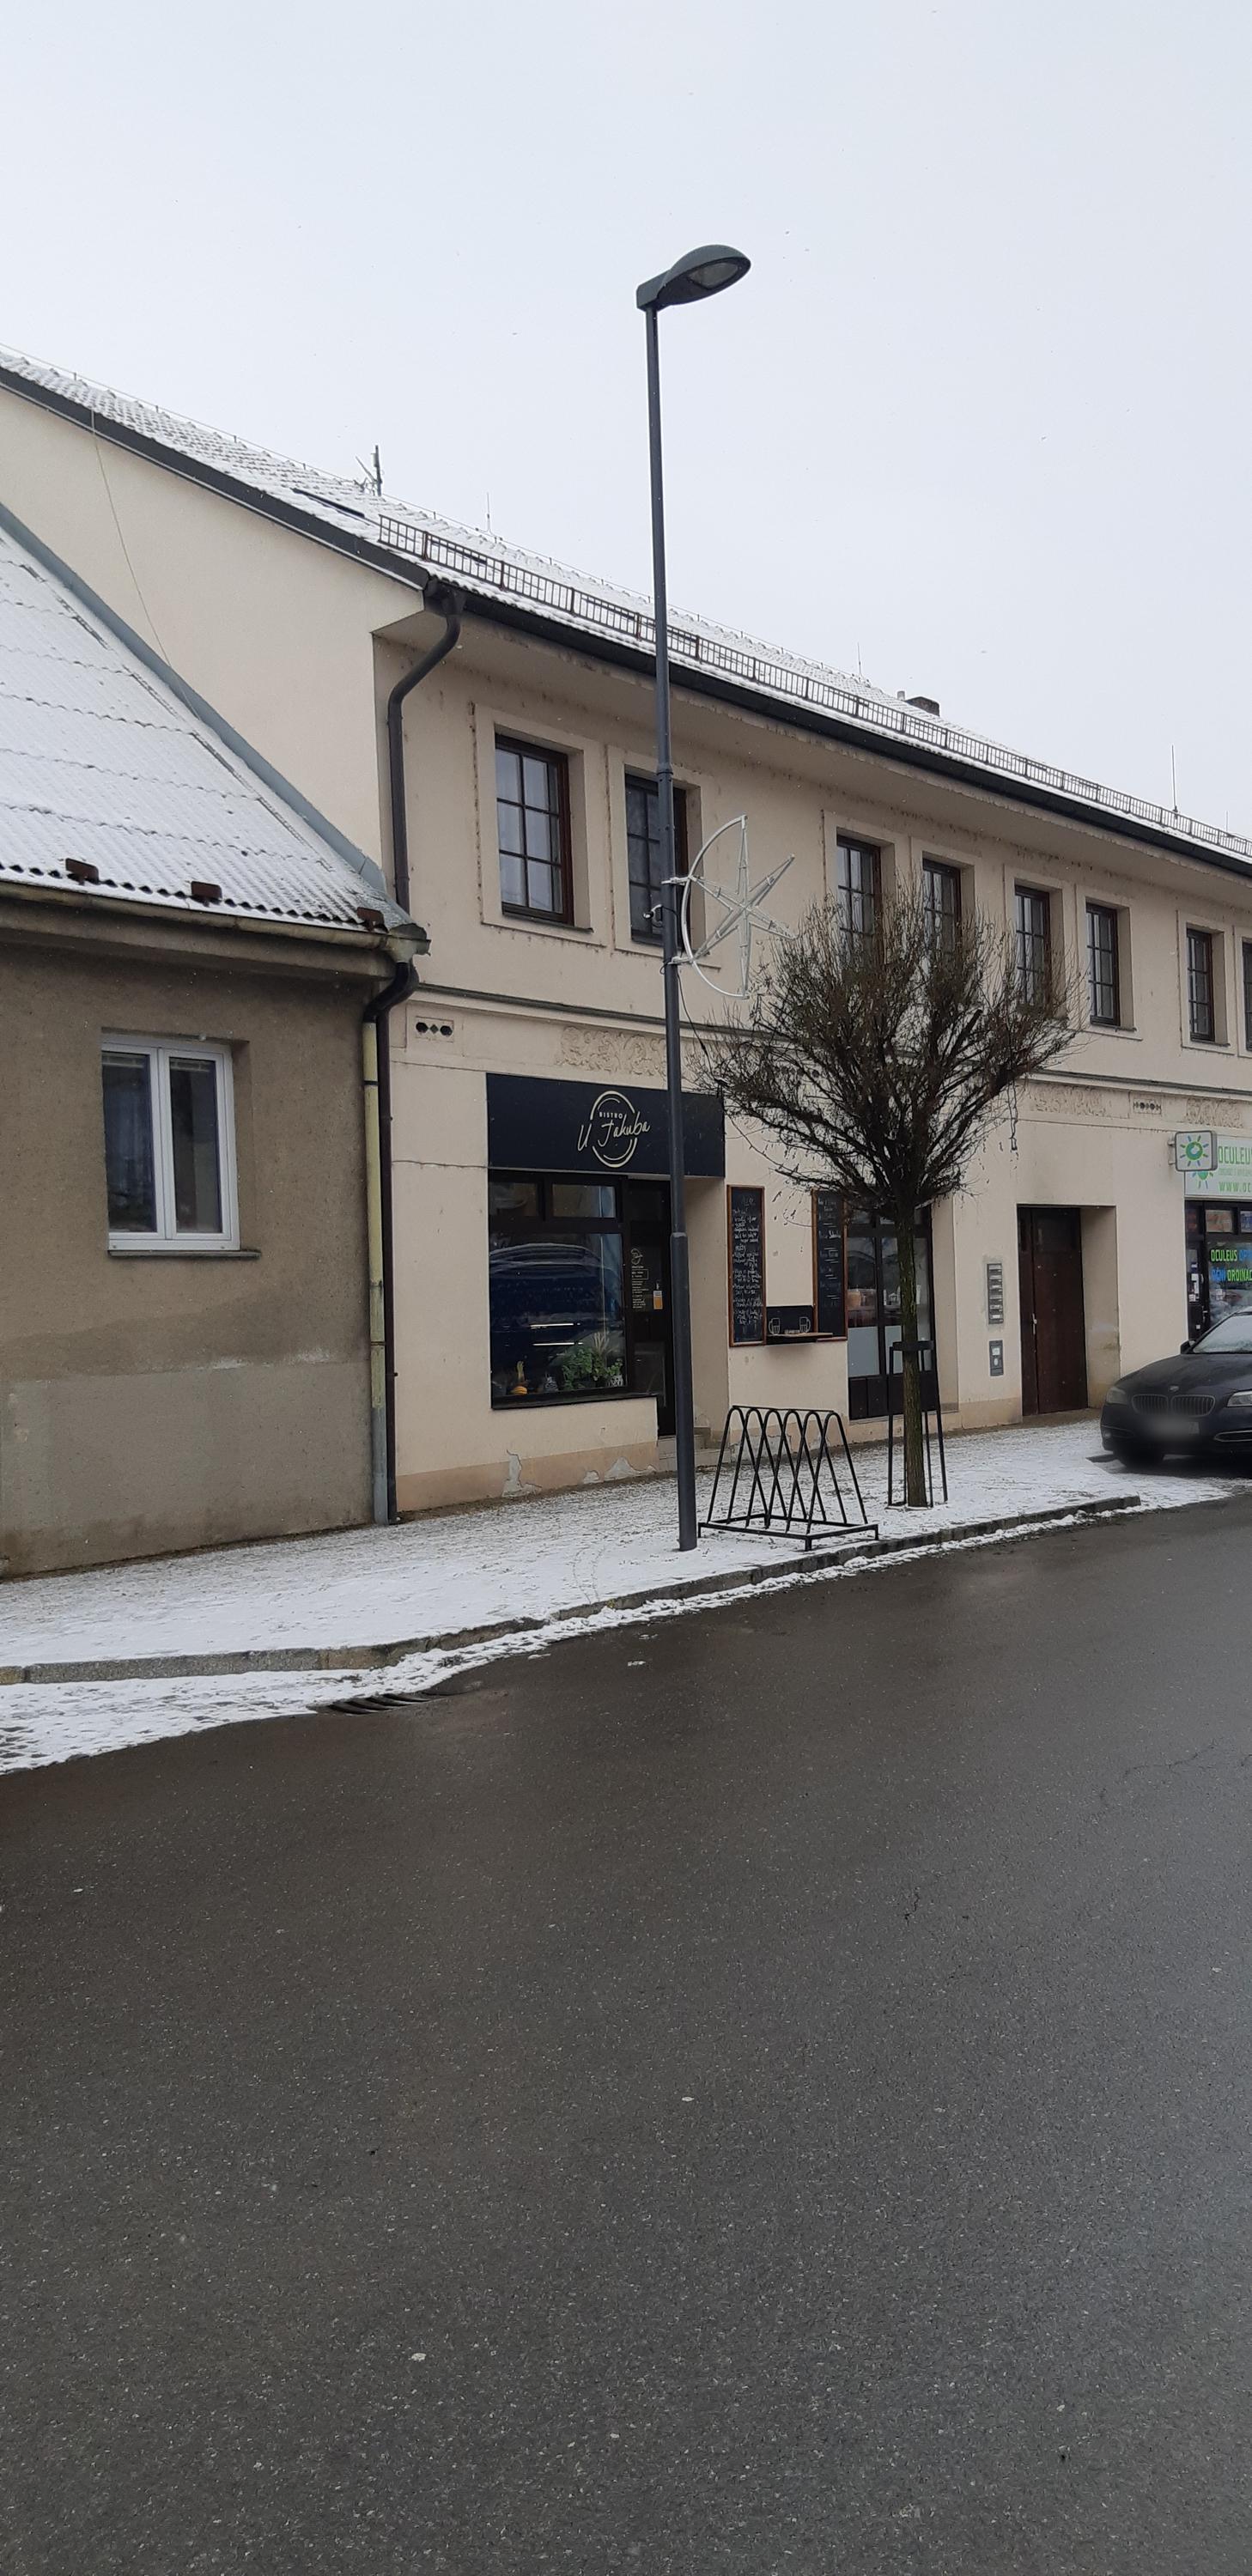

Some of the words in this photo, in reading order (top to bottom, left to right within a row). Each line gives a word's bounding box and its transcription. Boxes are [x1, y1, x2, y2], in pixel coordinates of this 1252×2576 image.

[577, 1122, 593, 1151] U
[597, 1110, 651, 1147] Jakuba
[1218, 1145, 1252, 1165] OCULEU
[1210, 1249, 1238, 1262] OCULEUS
